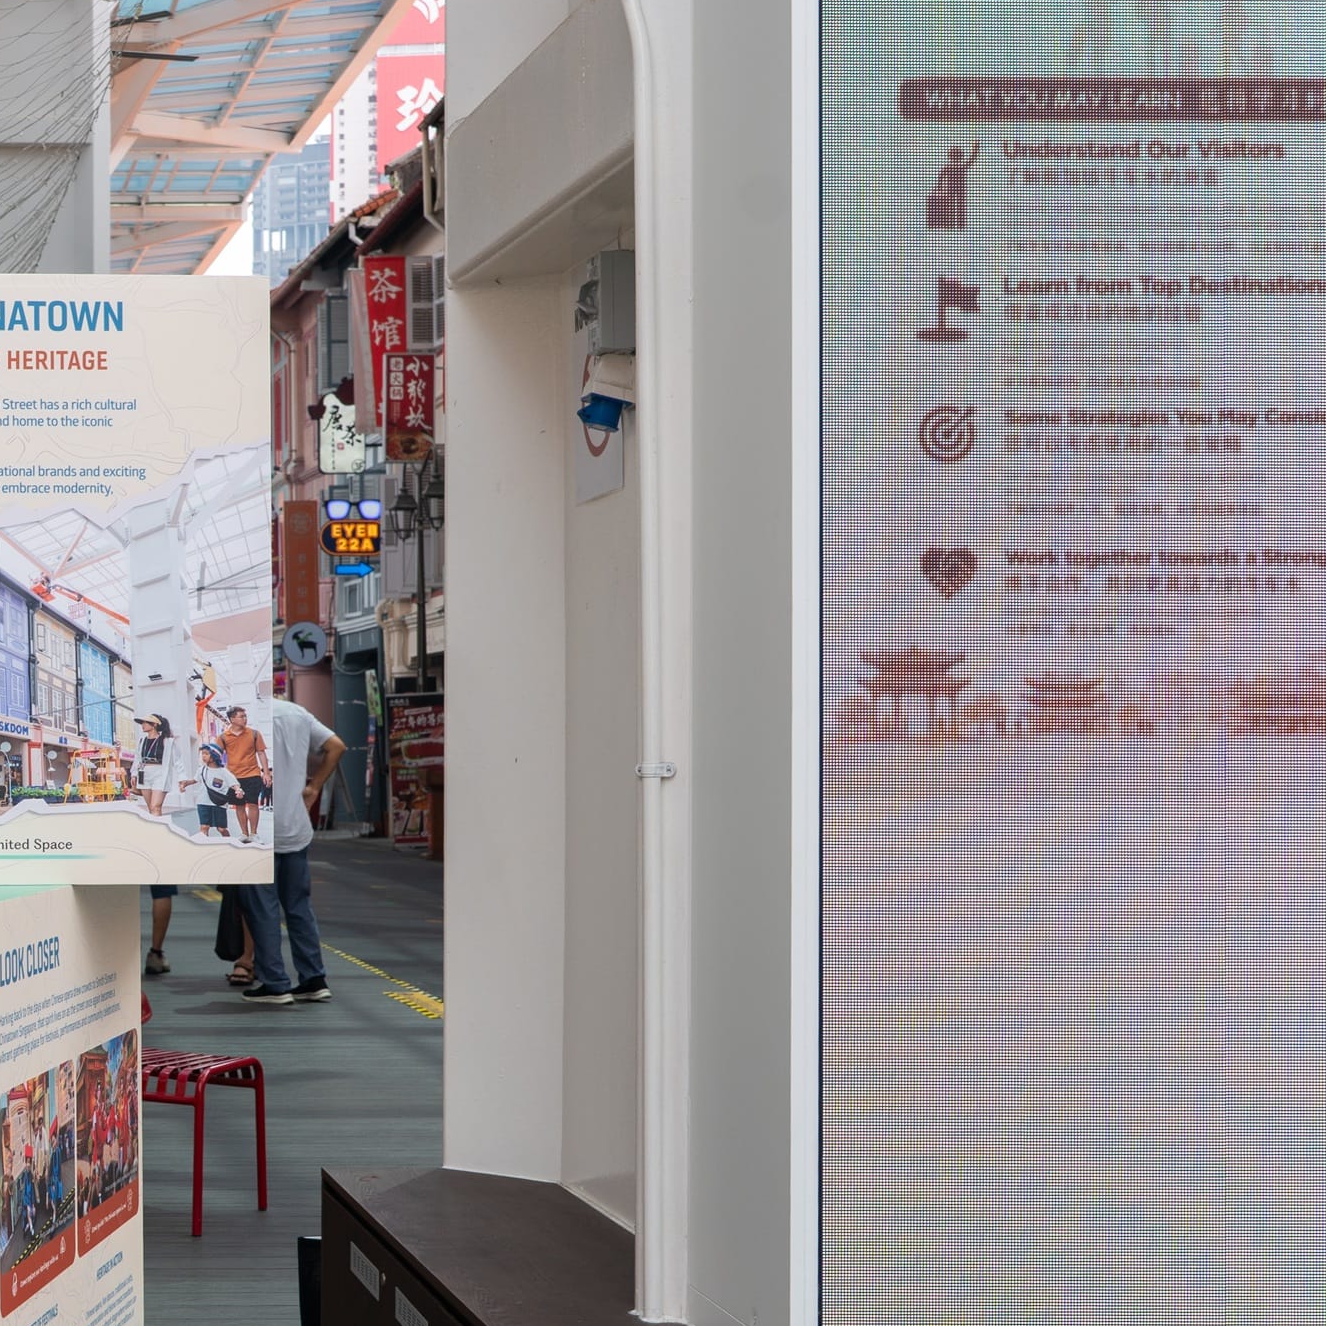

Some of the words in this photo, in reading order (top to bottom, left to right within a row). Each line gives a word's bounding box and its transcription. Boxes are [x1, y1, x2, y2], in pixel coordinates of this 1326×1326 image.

[925, 88, 994, 111] WHAT
[1001, 88, 1049, 111] YOU
[1054, 88, 1102, 111] MAY
[1108, 88, 1183, 111] LEARN
[1002, 140, 1140, 161] Understand
[1147, 141, 1189, 161] Our
[1197, 140, 1286, 161] Visitors
[1003, 277, 1069, 297] Learn
[1076, 276, 1132, 297] from
[1139, 277, 1182, 300] Top
[8, 350, 107, 370] HERITAGE
[3, 397, 38, 410] Street
[40, 398, 60, 410] has
[62, 401, 69, 410] a
[72, 398, 92, 410] rich
[95, 398, 137, 410] cultural
[1005, 410, 1062, 426] Some
[1067, 409, 1169, 429] Strategies
[1176, 409, 1212, 426] You
[1218, 409, 1258, 429] May
[337, 539, 373, 551] 22A
[1005, 550, 1057, 566] Work
[1065, 550, 1152, 569] together
[1158, 549, 1239, 566] towards
[1245, 552, 1257, 566] a
[34, 839, 72, 852] Space
[0, 947, 24, 987] LOOK
[27, 936, 60, 977] CLOSER
